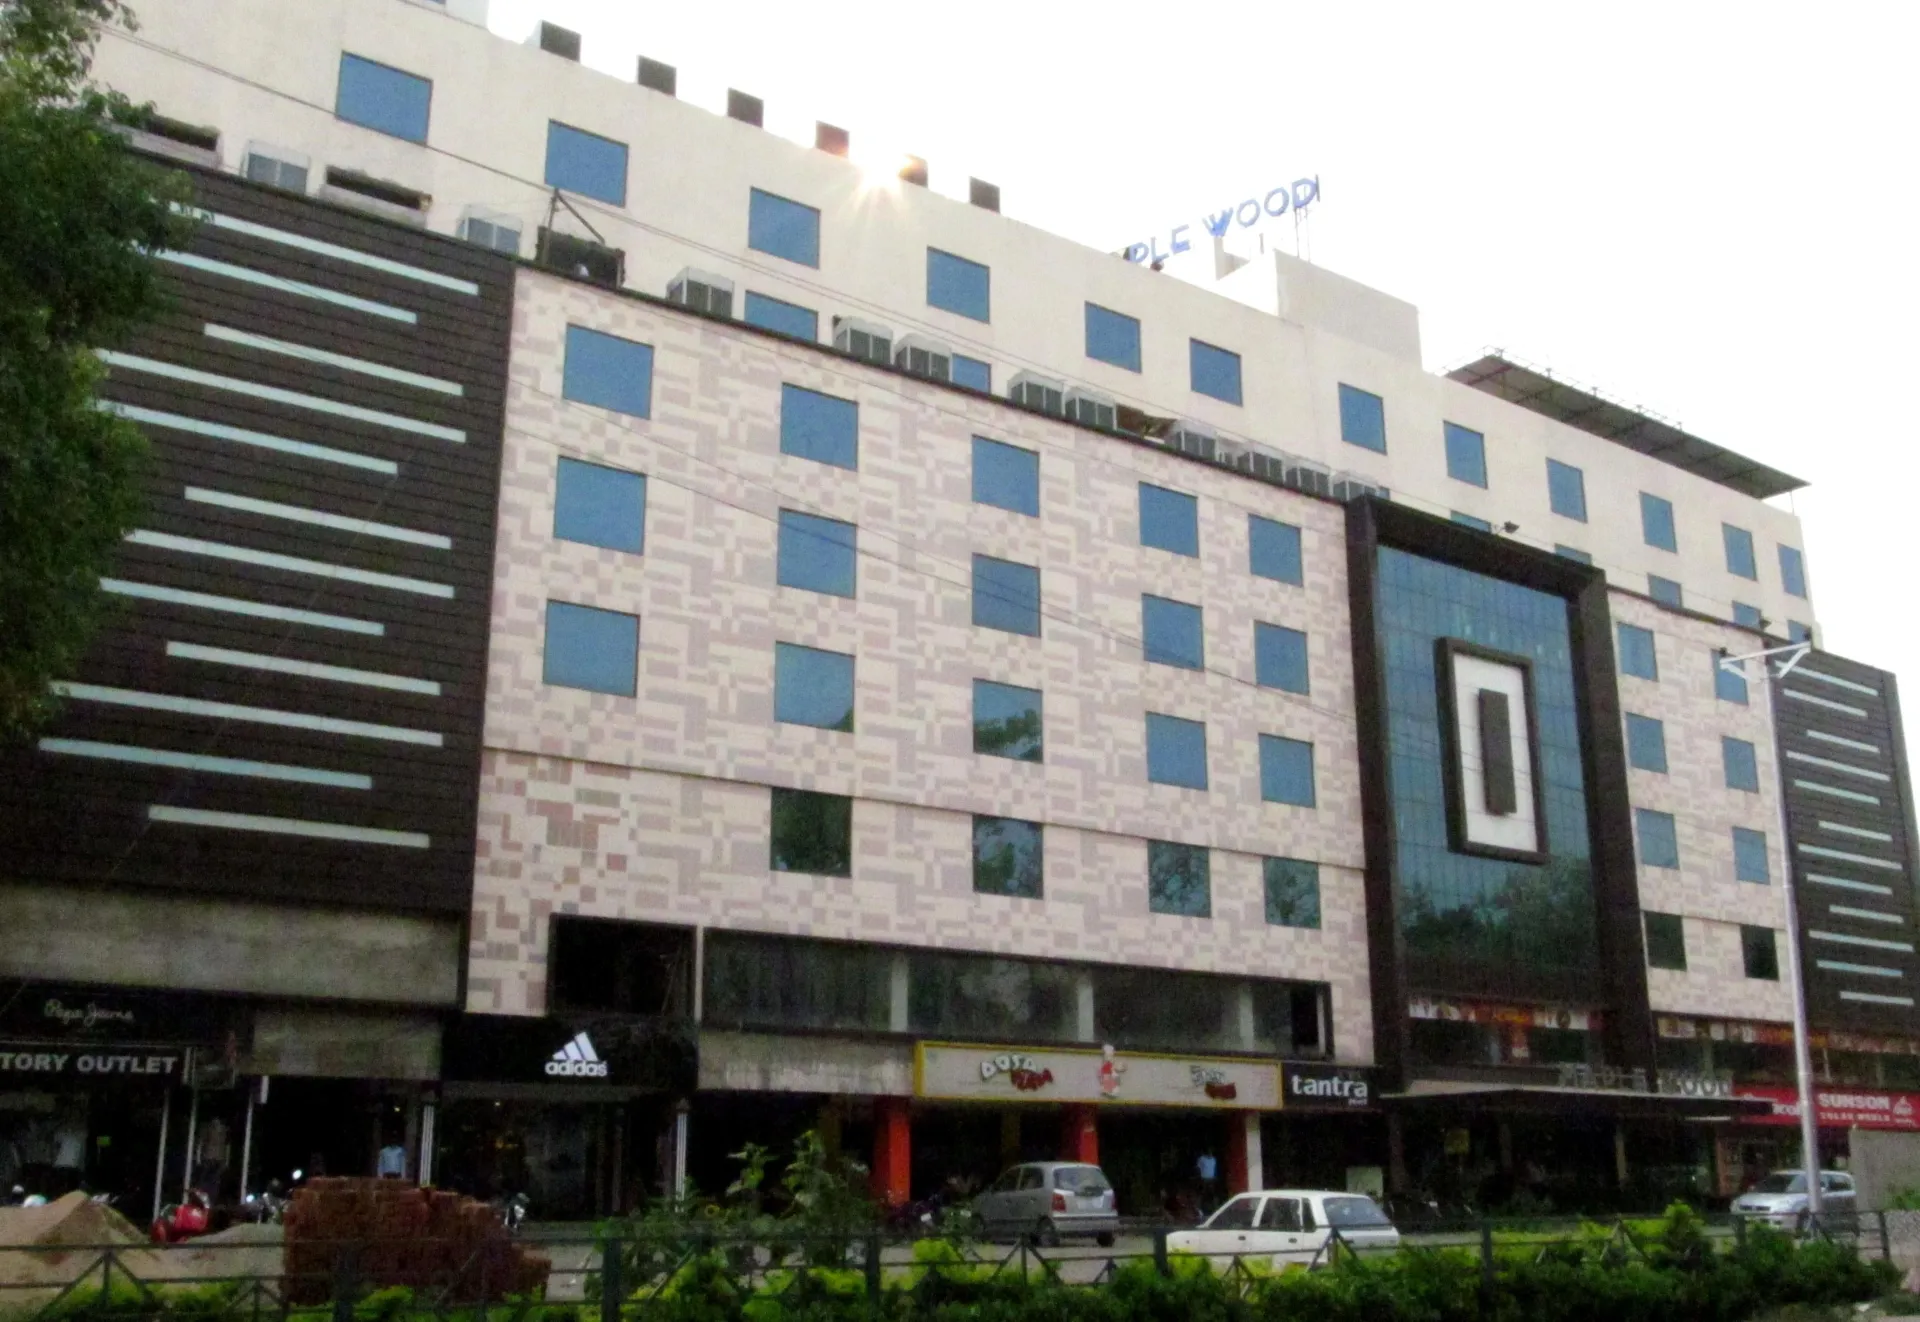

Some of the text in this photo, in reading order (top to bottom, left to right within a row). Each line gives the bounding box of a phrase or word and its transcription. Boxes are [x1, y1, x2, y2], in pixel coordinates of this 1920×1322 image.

[1203, 177, 1318, 237] WOOD
[76, 1054, 178, 1075] OUTLET
[544, 1060, 608, 1077] adidas
[1291, 1074, 1368, 1098] tantra
[1818, 1093, 1890, 1110] SUNSON
